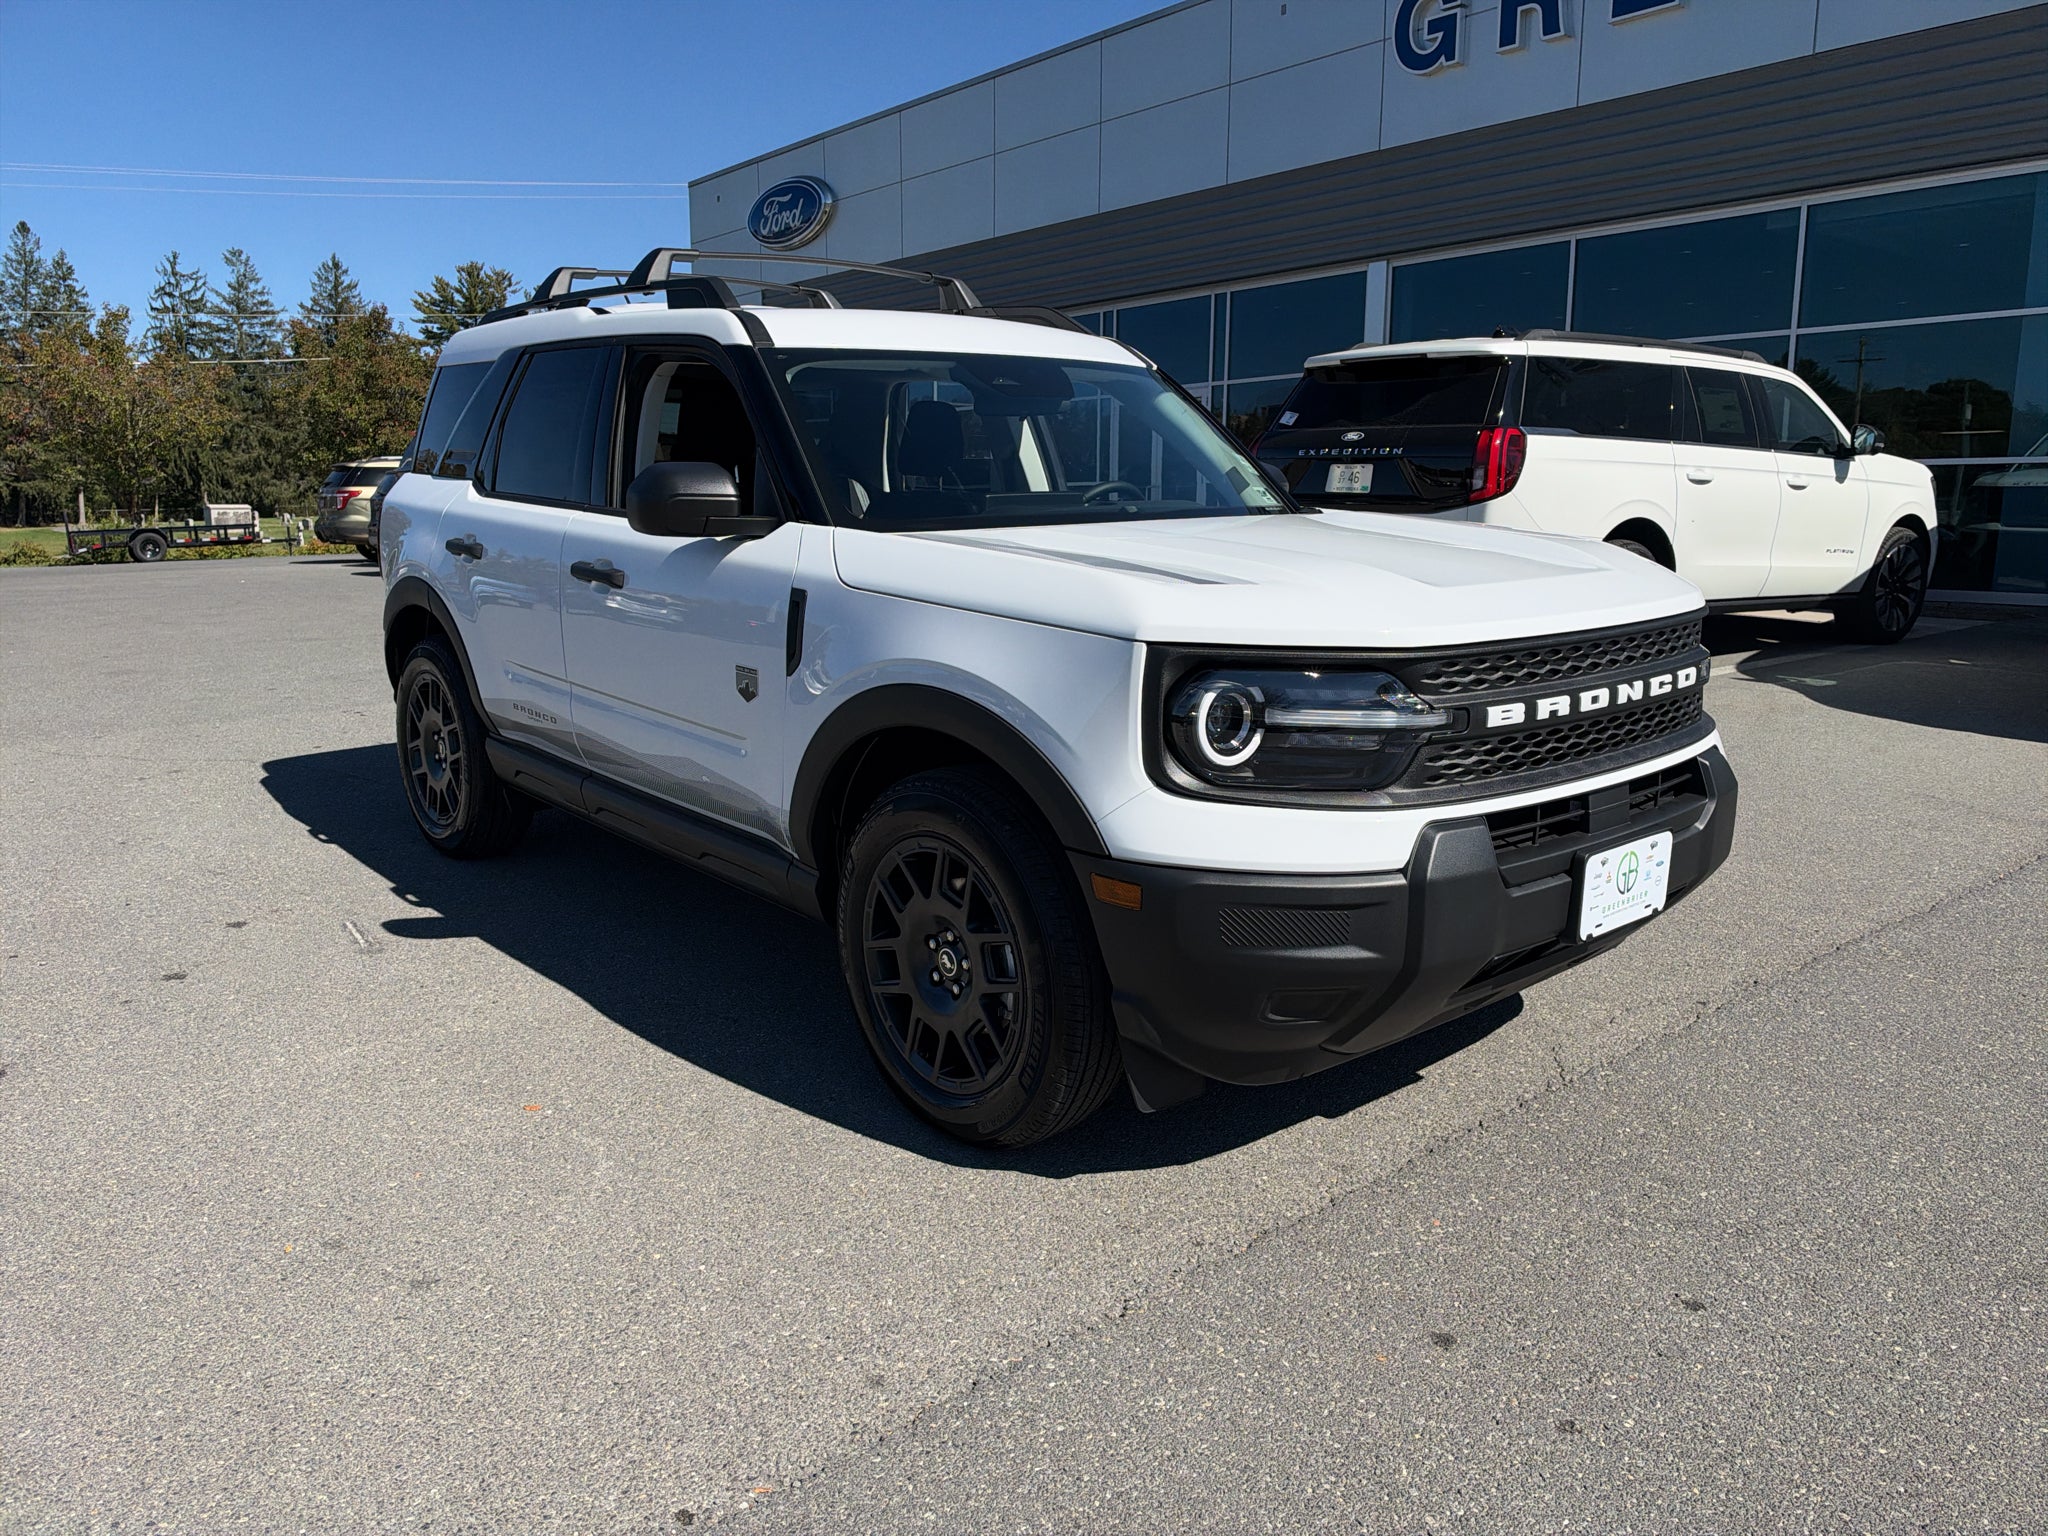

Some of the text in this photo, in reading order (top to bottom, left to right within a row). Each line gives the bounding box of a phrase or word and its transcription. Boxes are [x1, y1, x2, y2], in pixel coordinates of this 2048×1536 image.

[760, 193, 805, 237] Ford
[1298, 447, 1403, 456] EXPEDITION
[1347, 471, 1361, 484] 46
[1486, 666, 1697, 728] BRONCO
[512, 702, 558, 725] BRONCO
[1601, 890, 1648, 914] GREENBRIER
[1021, 991, 1044, 1090] MICHELIN
